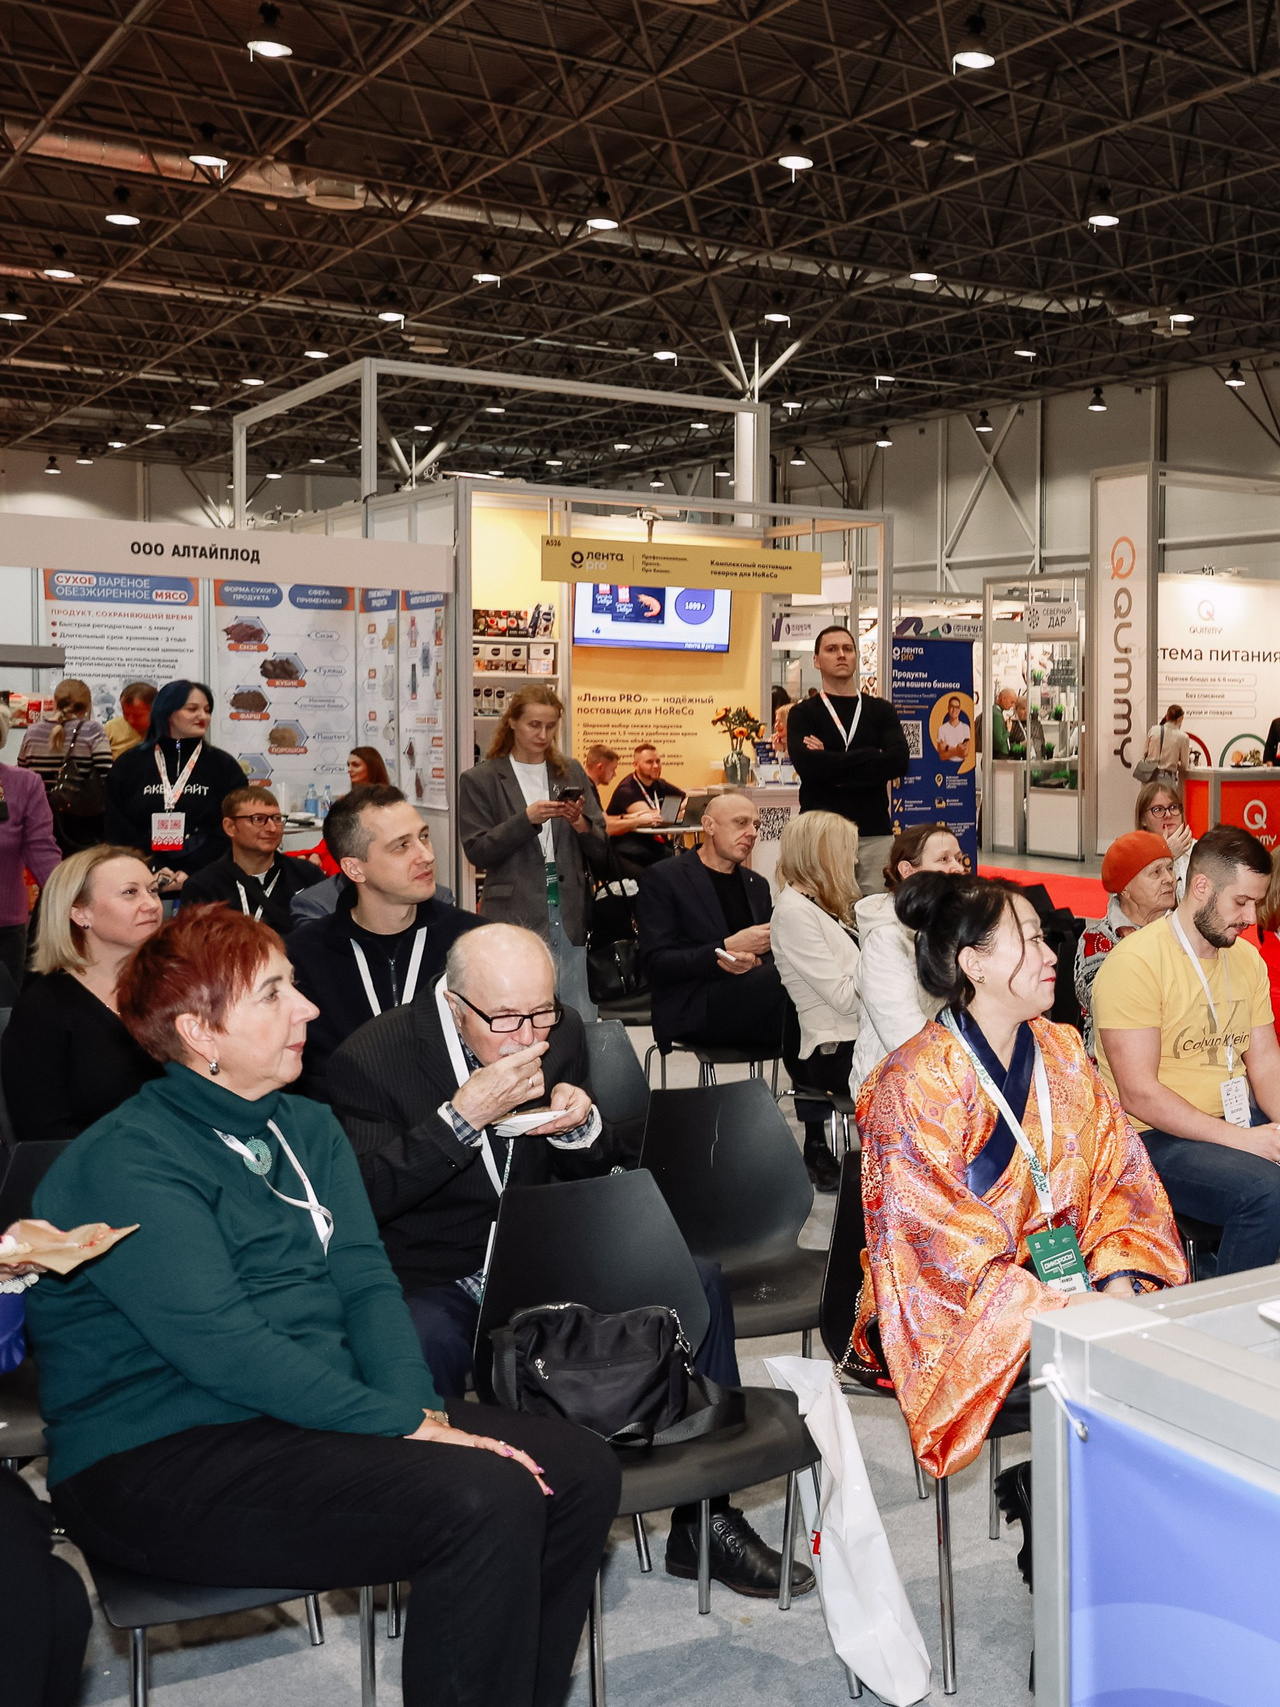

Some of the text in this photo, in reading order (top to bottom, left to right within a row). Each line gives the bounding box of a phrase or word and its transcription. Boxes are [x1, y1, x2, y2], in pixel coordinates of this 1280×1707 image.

[130, 542, 260, 564] ООО АЛТАЙПЛОД
[586, 551, 624, 562] лента
[585, 561, 607, 571] pro
[710, 560, 756, 568] Комплексный
[56, 575, 150, 588] СУХОЕ ВАРЁНОЕ
[56, 586, 187, 601] ОБЕЗЖИРЕННОЕ МЯСО
[224, 585, 278, 594] ФОРМА СУХОГО
[232, 594, 270, 602] ПРОДУКТА
[296, 597, 343, 605] ПРИМЕНЕНИЯ
[96, 611, 164, 620] СОХРАНЯЮЩИЙ
[1043, 606, 1072, 616] СЕВЕРНЫЙ
[1048, 616, 1066, 629] ДАР
[901, 647, 924, 655] лента
[892, 669, 928, 680] Продукты
[892, 681, 904, 689] для
[933, 680, 960, 689] бизнеса
[577, 693, 616, 703] «Лента
[663, 695, 714, 704] надёжный
[577, 706, 694, 716] поставщик для HoReCa
[1182, 1031, 1250, 1051] Calvin Klein
